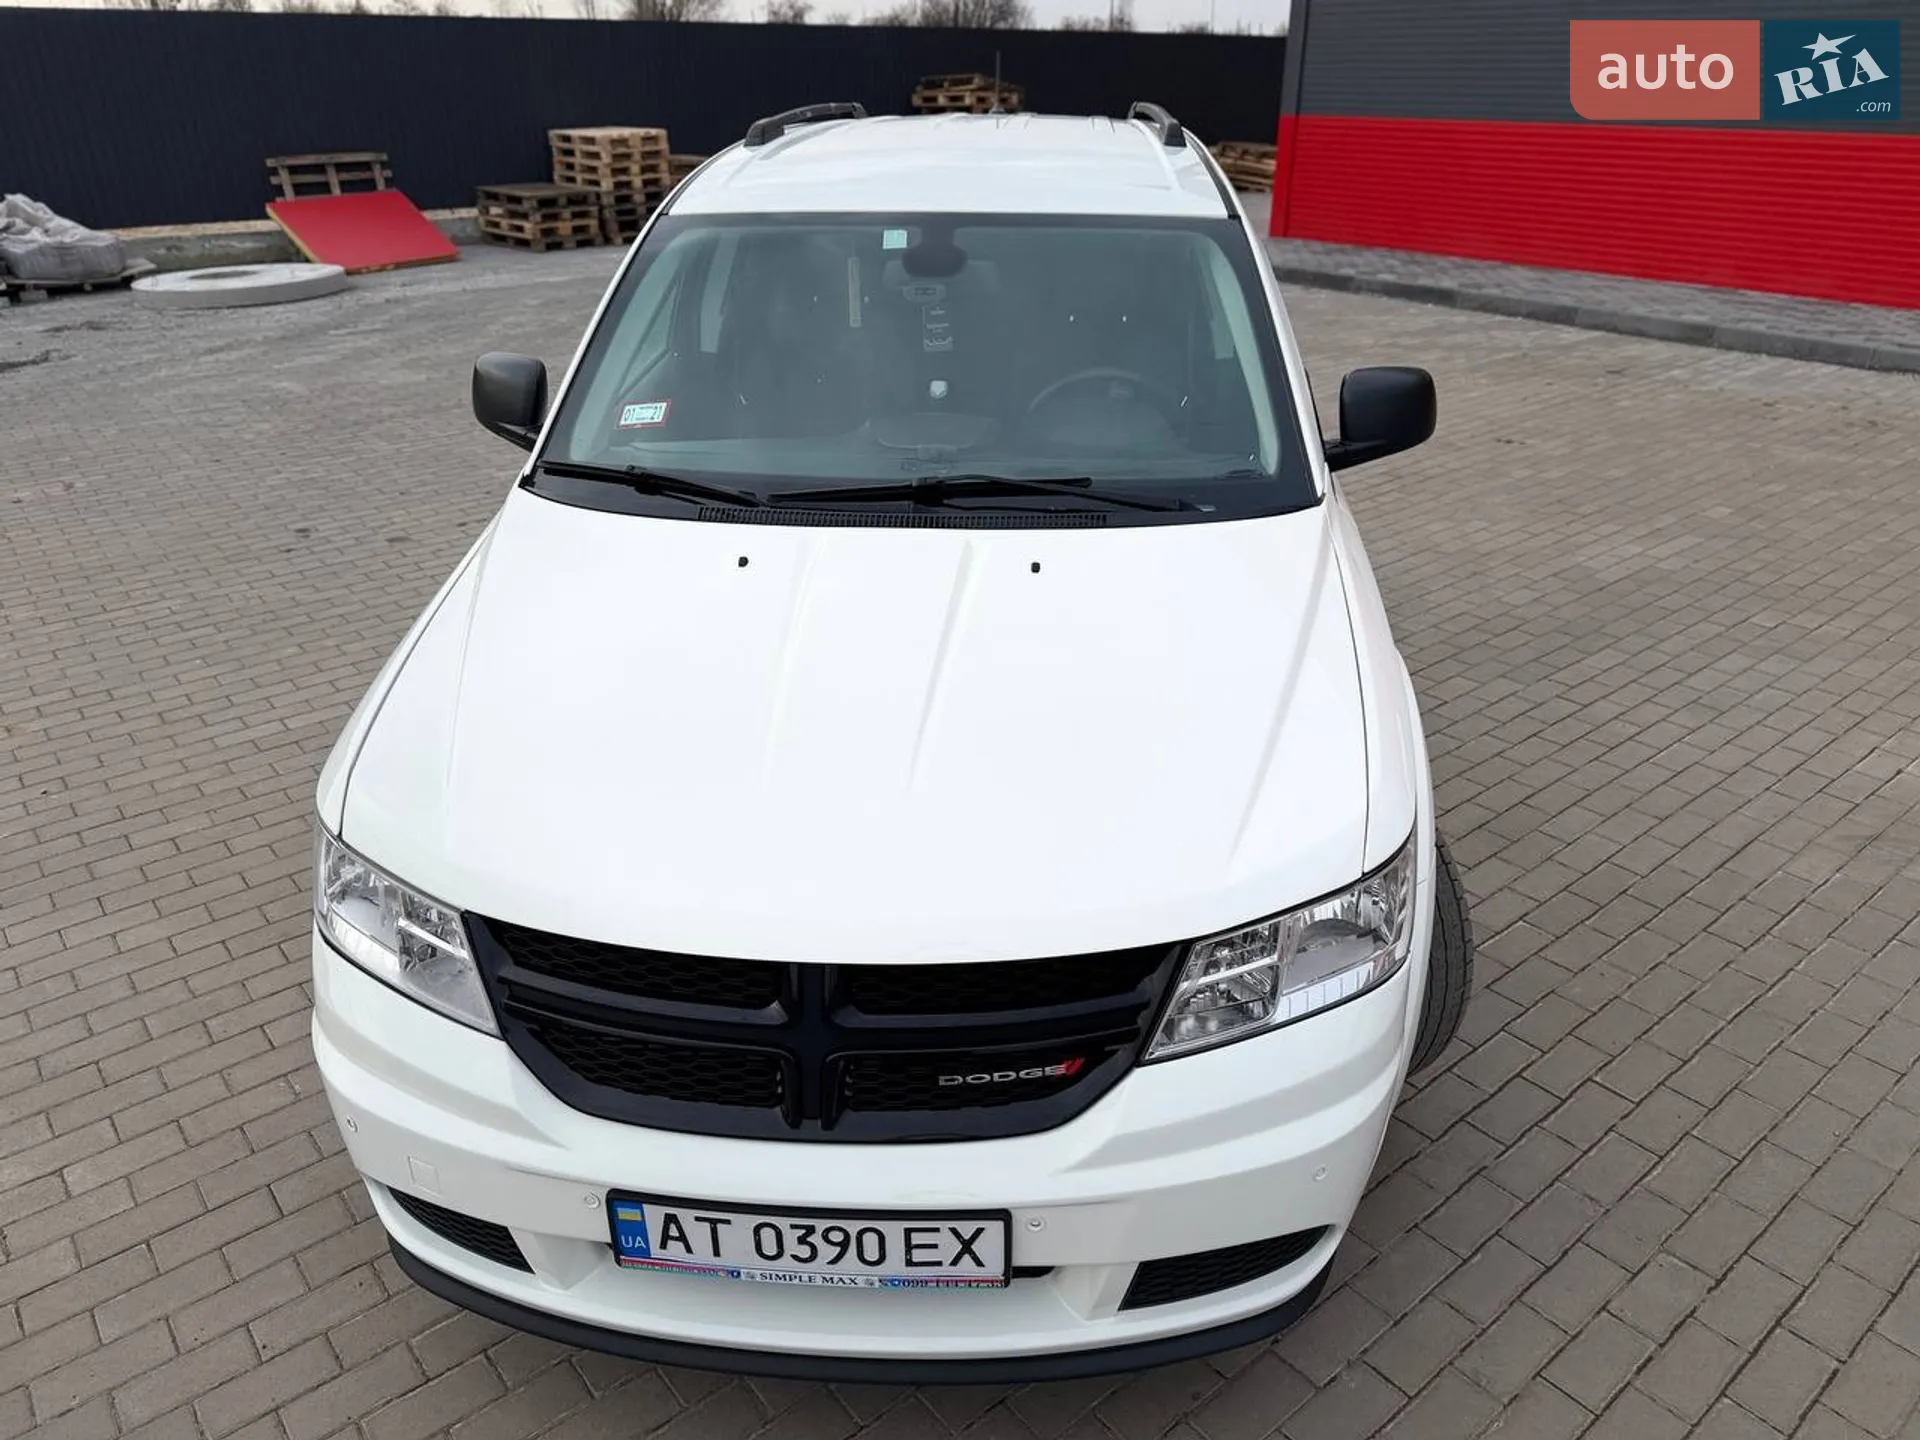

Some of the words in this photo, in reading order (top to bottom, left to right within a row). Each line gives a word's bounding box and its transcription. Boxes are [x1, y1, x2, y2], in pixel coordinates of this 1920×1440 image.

[938, 1064, 1067, 1086] DODGE
[620, 1235, 647, 1249] UA
[658, 1211, 732, 1258] AT
[753, 1221, 887, 1268] 0390
[903, 1226, 986, 1268] EX
[760, 1271, 817, 1284] SIMPLE
[820, 1275, 859, 1286] MAX
